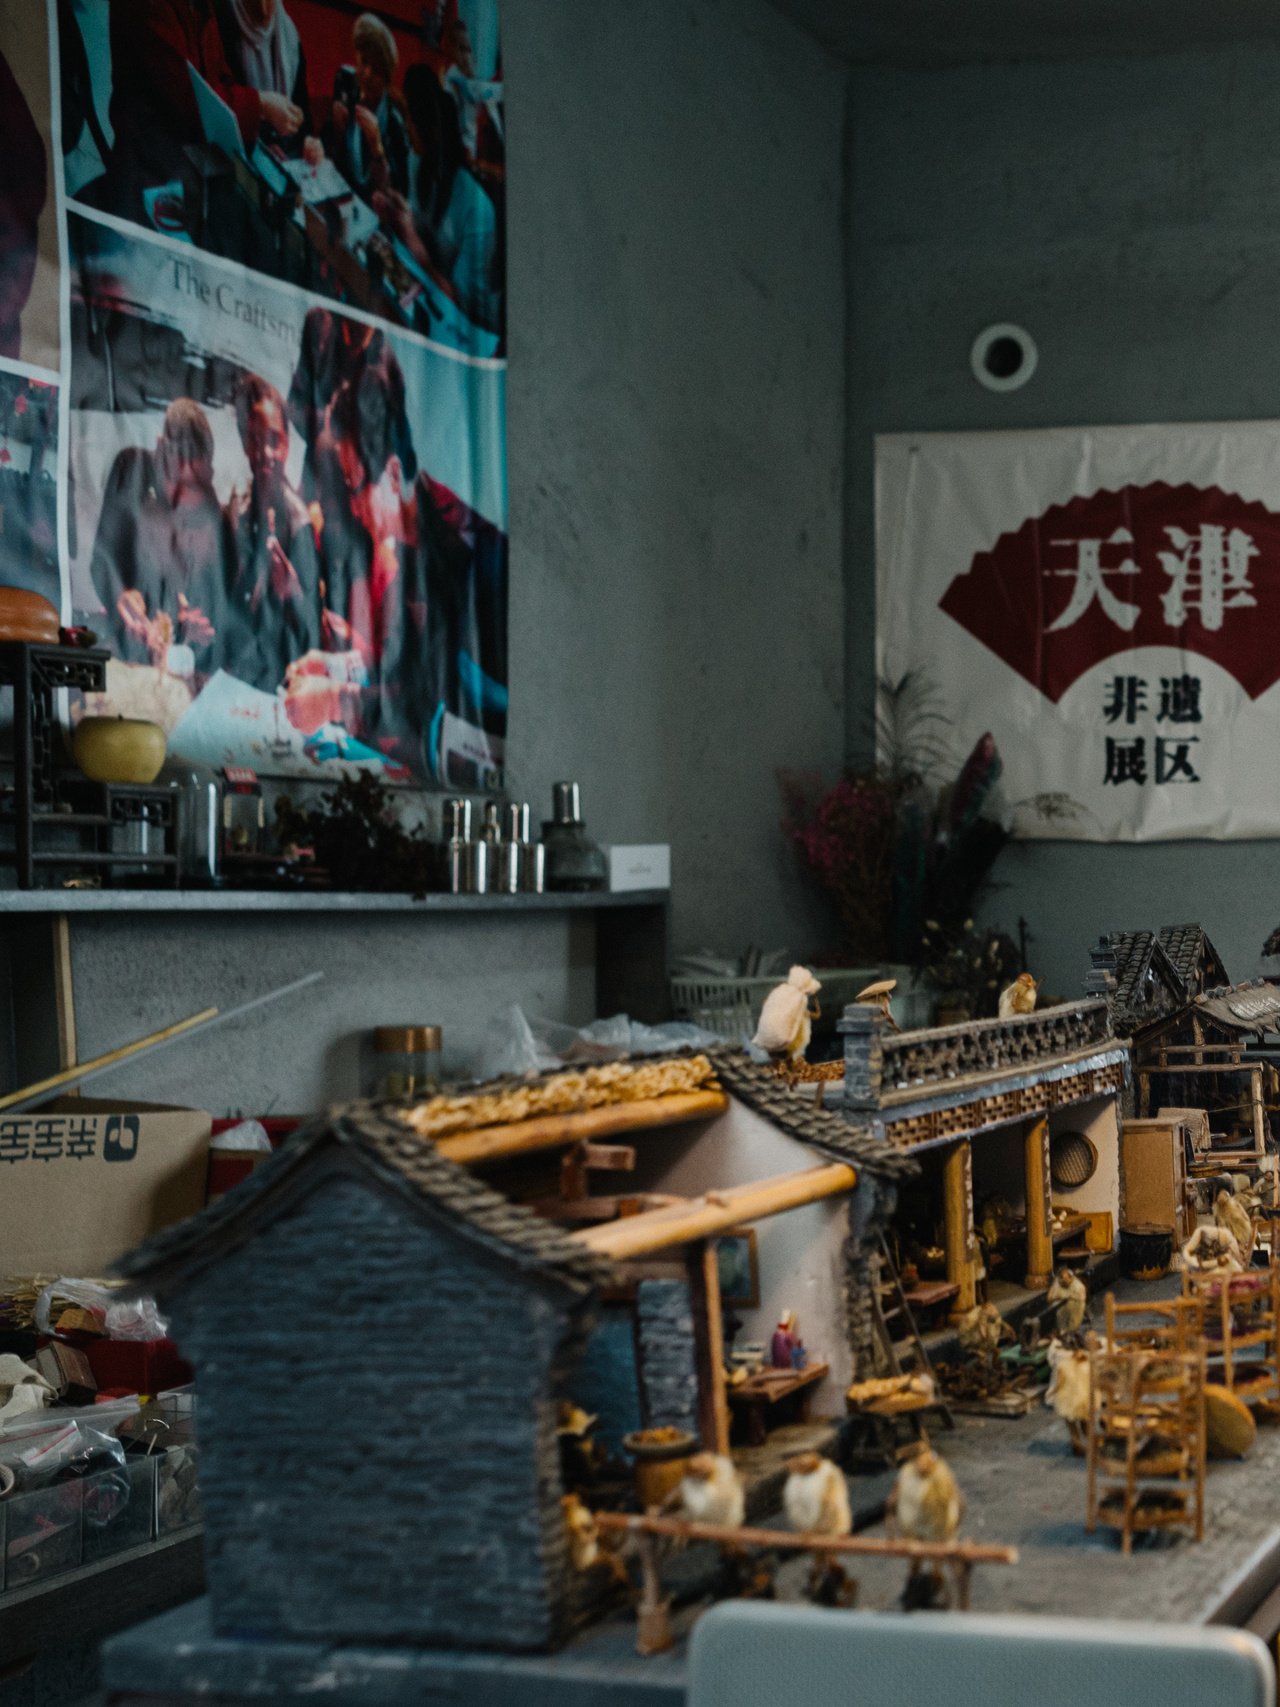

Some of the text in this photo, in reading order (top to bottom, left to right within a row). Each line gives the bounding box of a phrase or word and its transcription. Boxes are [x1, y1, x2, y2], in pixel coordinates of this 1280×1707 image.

[168, 254, 211, 306] The
[1042, 523, 1261, 633] 天津
[1102, 673, 1203, 725] 非遗
[1103, 736, 1201, 787] 展区
